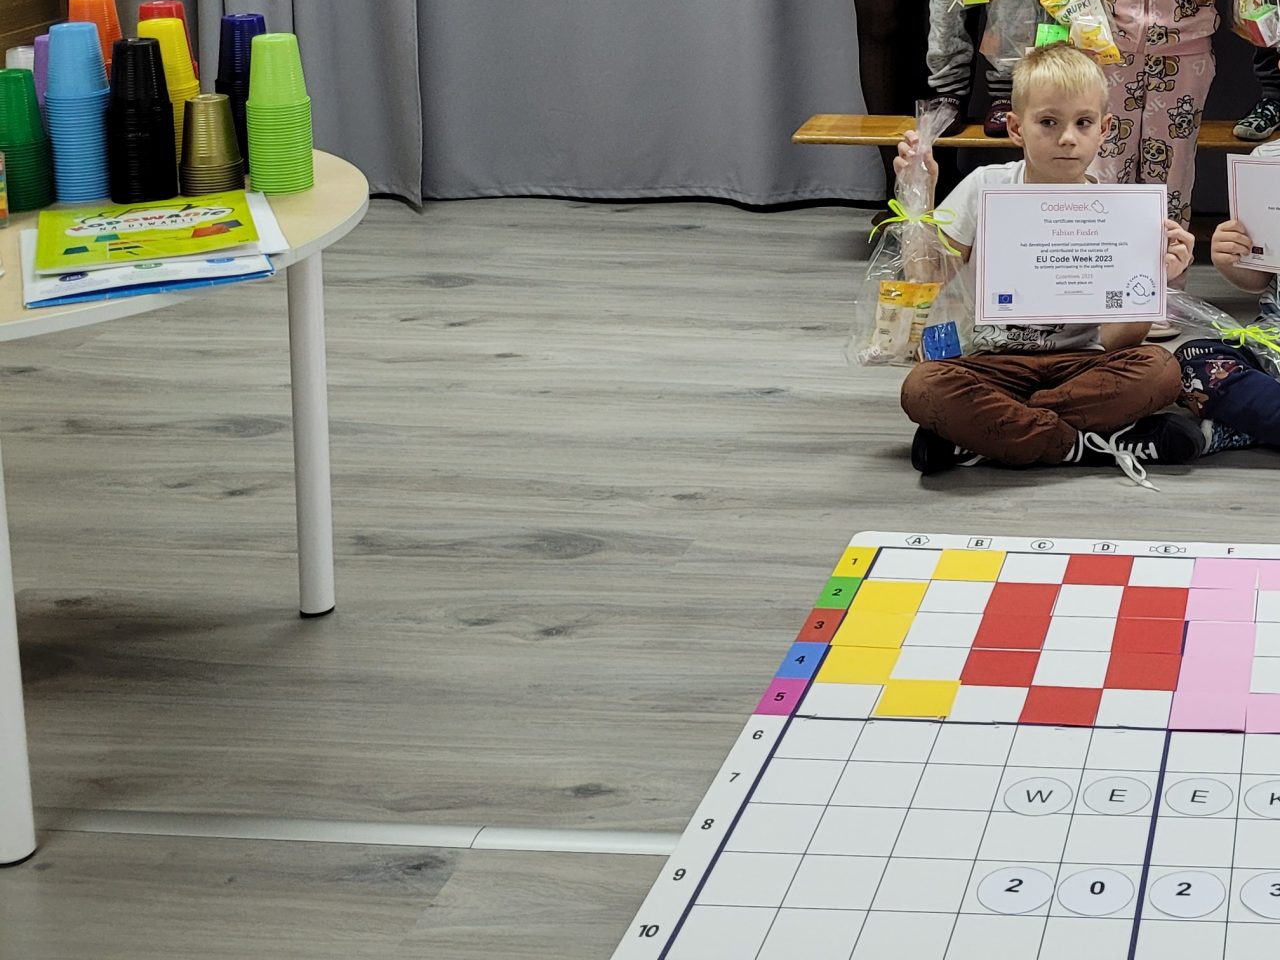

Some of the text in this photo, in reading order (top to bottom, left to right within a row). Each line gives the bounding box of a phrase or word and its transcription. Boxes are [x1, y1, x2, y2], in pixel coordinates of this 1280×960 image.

[912, 537, 922, 545] A
[975, 539, 984, 547] B
[1037, 541, 1047, 549] C
[832, 588, 842, 596] 2
[814, 621, 825, 630] 3
[795, 655, 806, 664] 4
[774, 692, 785, 701] 5
[753, 730, 764, 740] 6
[729, 773, 741, 783] 7
[701, 819, 714, 830] 8
[672, 868, 686, 881] 9
[638, 925, 660, 938] 10
